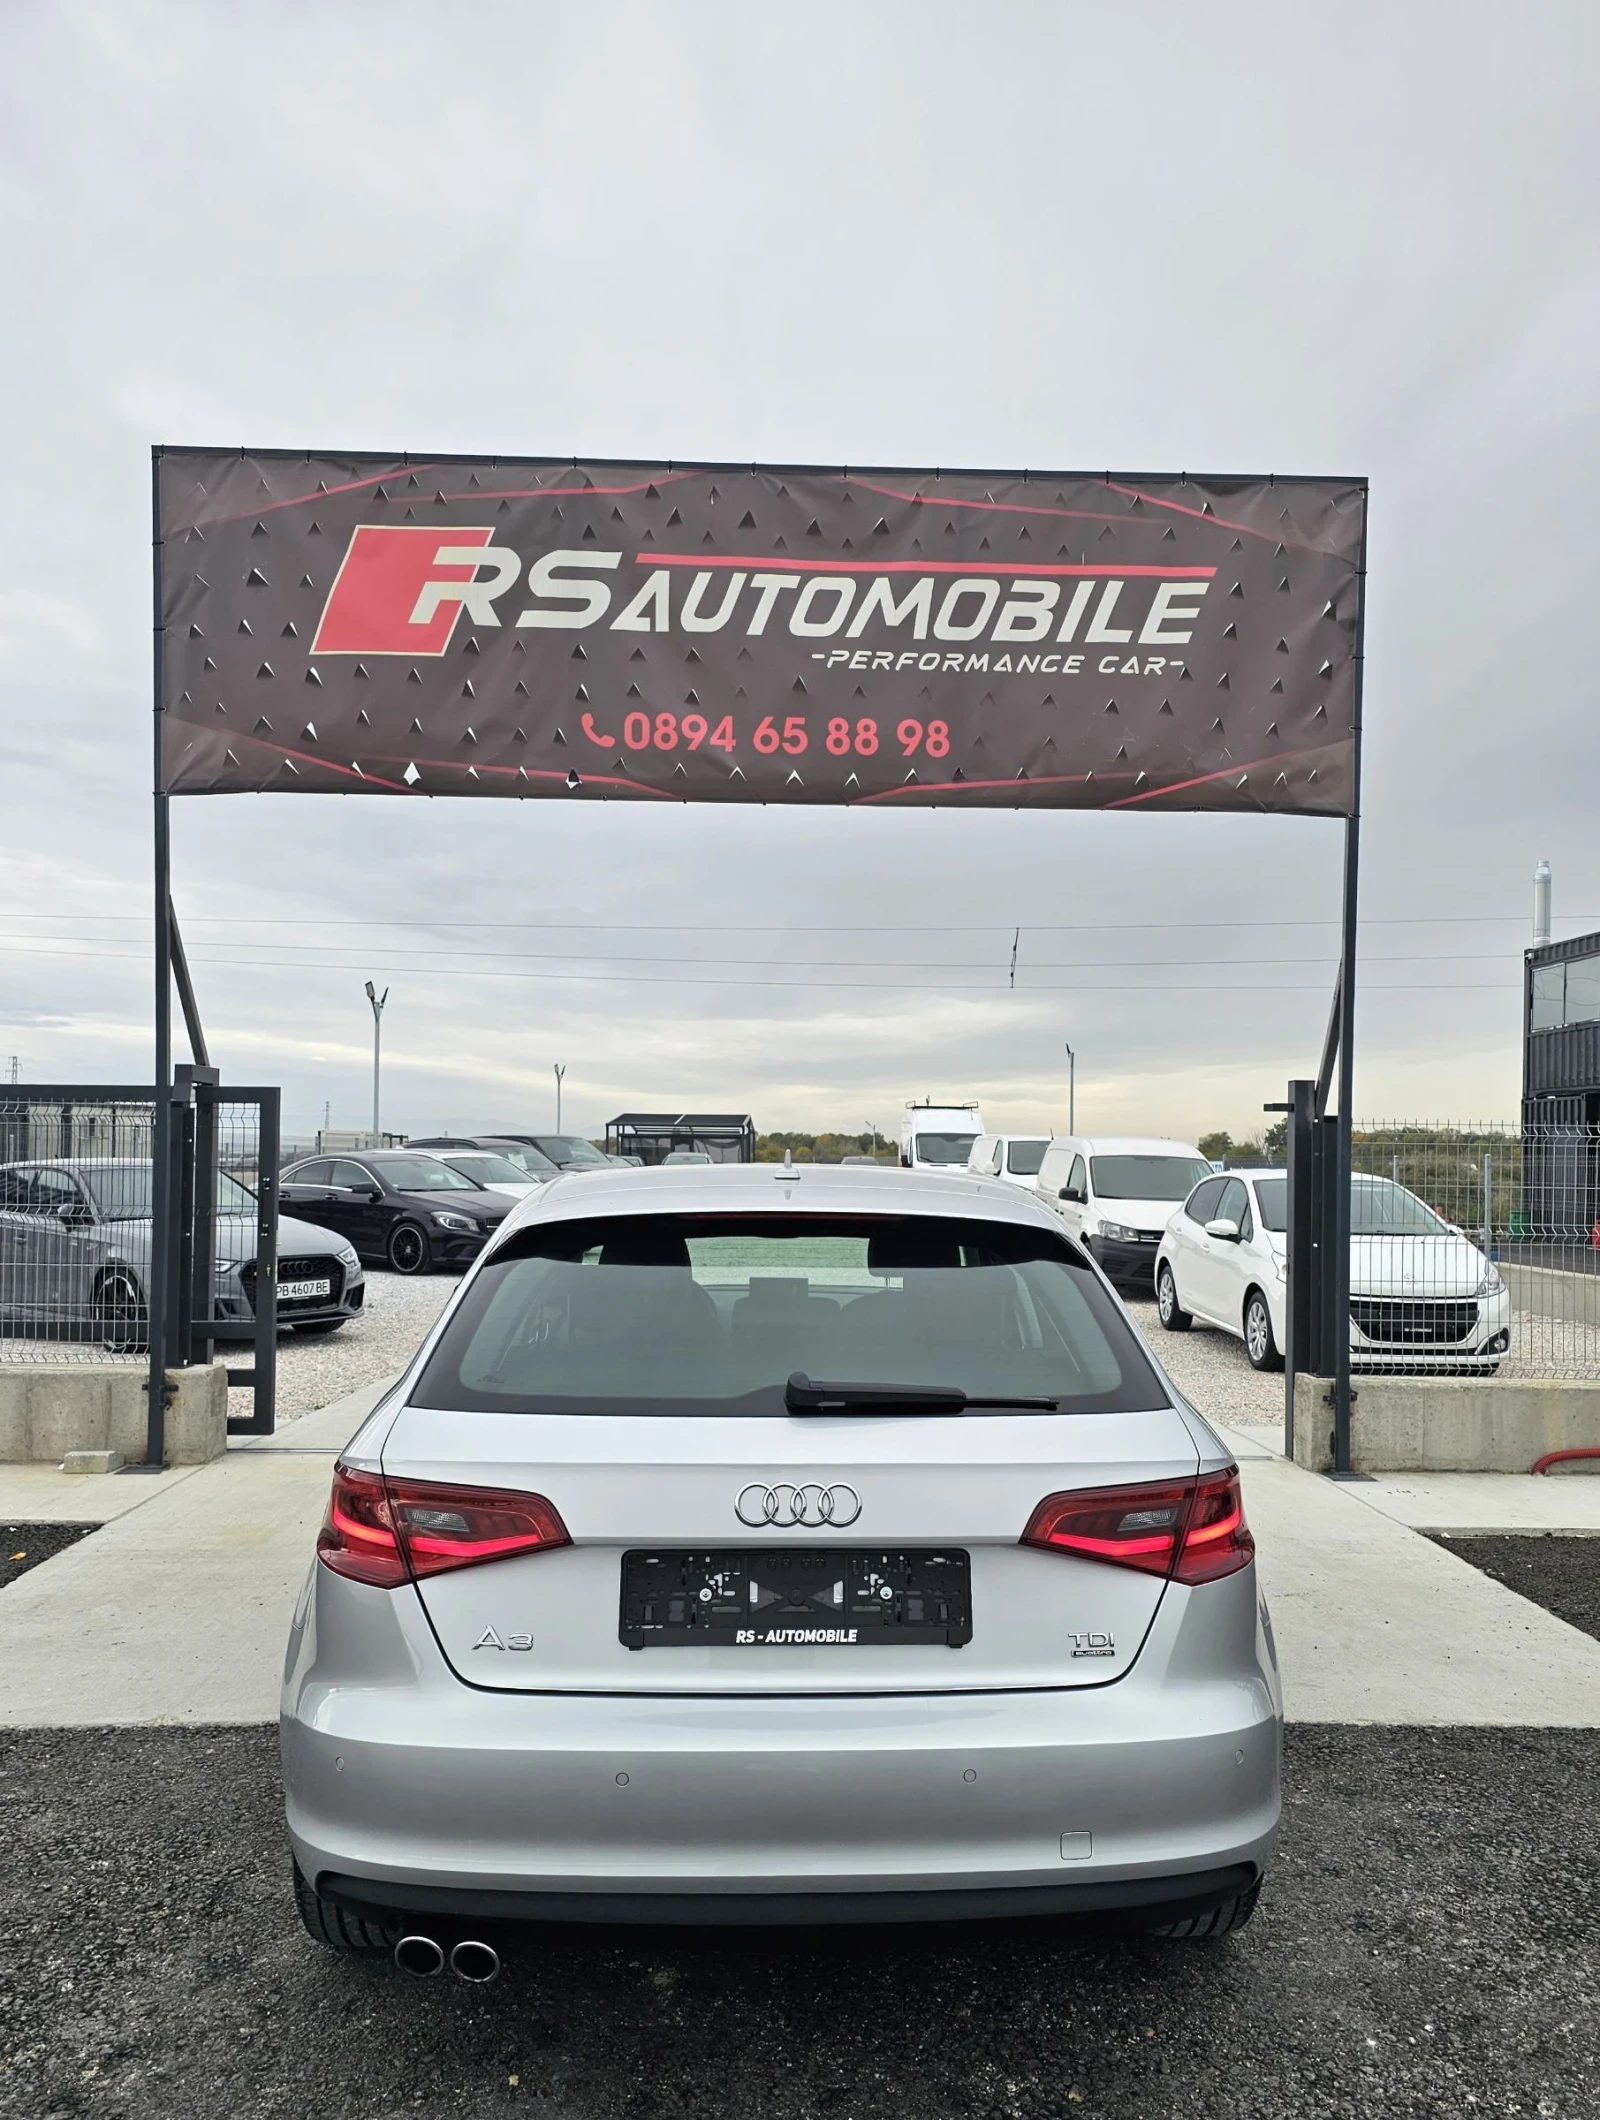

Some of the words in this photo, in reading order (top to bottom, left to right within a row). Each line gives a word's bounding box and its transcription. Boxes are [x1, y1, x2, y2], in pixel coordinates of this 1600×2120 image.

[408, 546, 622, 629] RS
[624, 712, 736, 752] 0894
[753, 716, 808, 755] 65
[825, 717, 879, 756] 88
[897, 718, 950, 757] 98
[291, 1282, 315, 1295] 4607
[316, 1281, 328, 1293] BE
[471, 1624, 534, 1651] A3
[736, 1630, 755, 1643] RS
[765, 1629, 858, 1642] AUTOMOBILE
[1068, 1632, 1114, 1648] TDI
